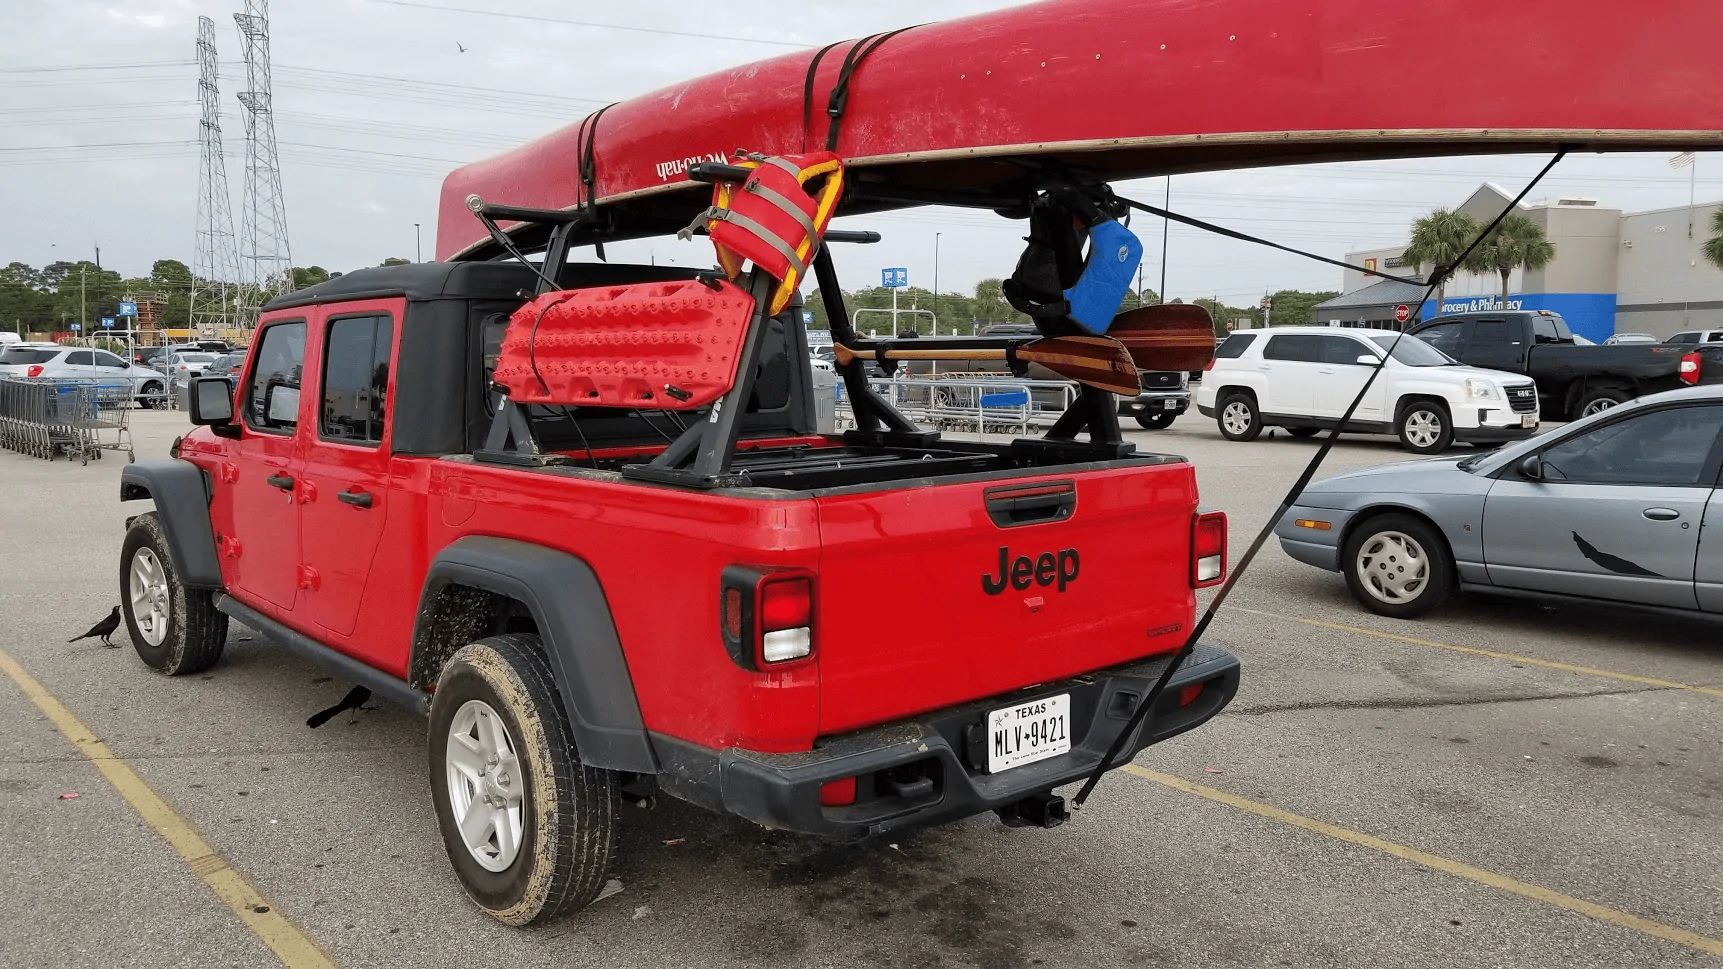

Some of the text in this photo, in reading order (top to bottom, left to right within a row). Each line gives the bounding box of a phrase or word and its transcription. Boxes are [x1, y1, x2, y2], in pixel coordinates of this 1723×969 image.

[1396, 309, 1409, 317] STOP
[1441, 301, 1470, 313] rocery
[1470, 299, 1478, 311] &
[981, 545, 1080, 595] Jeep
[1146, 622, 1183, 638] SPORT
[1015, 702, 1047, 720] TEXAS
